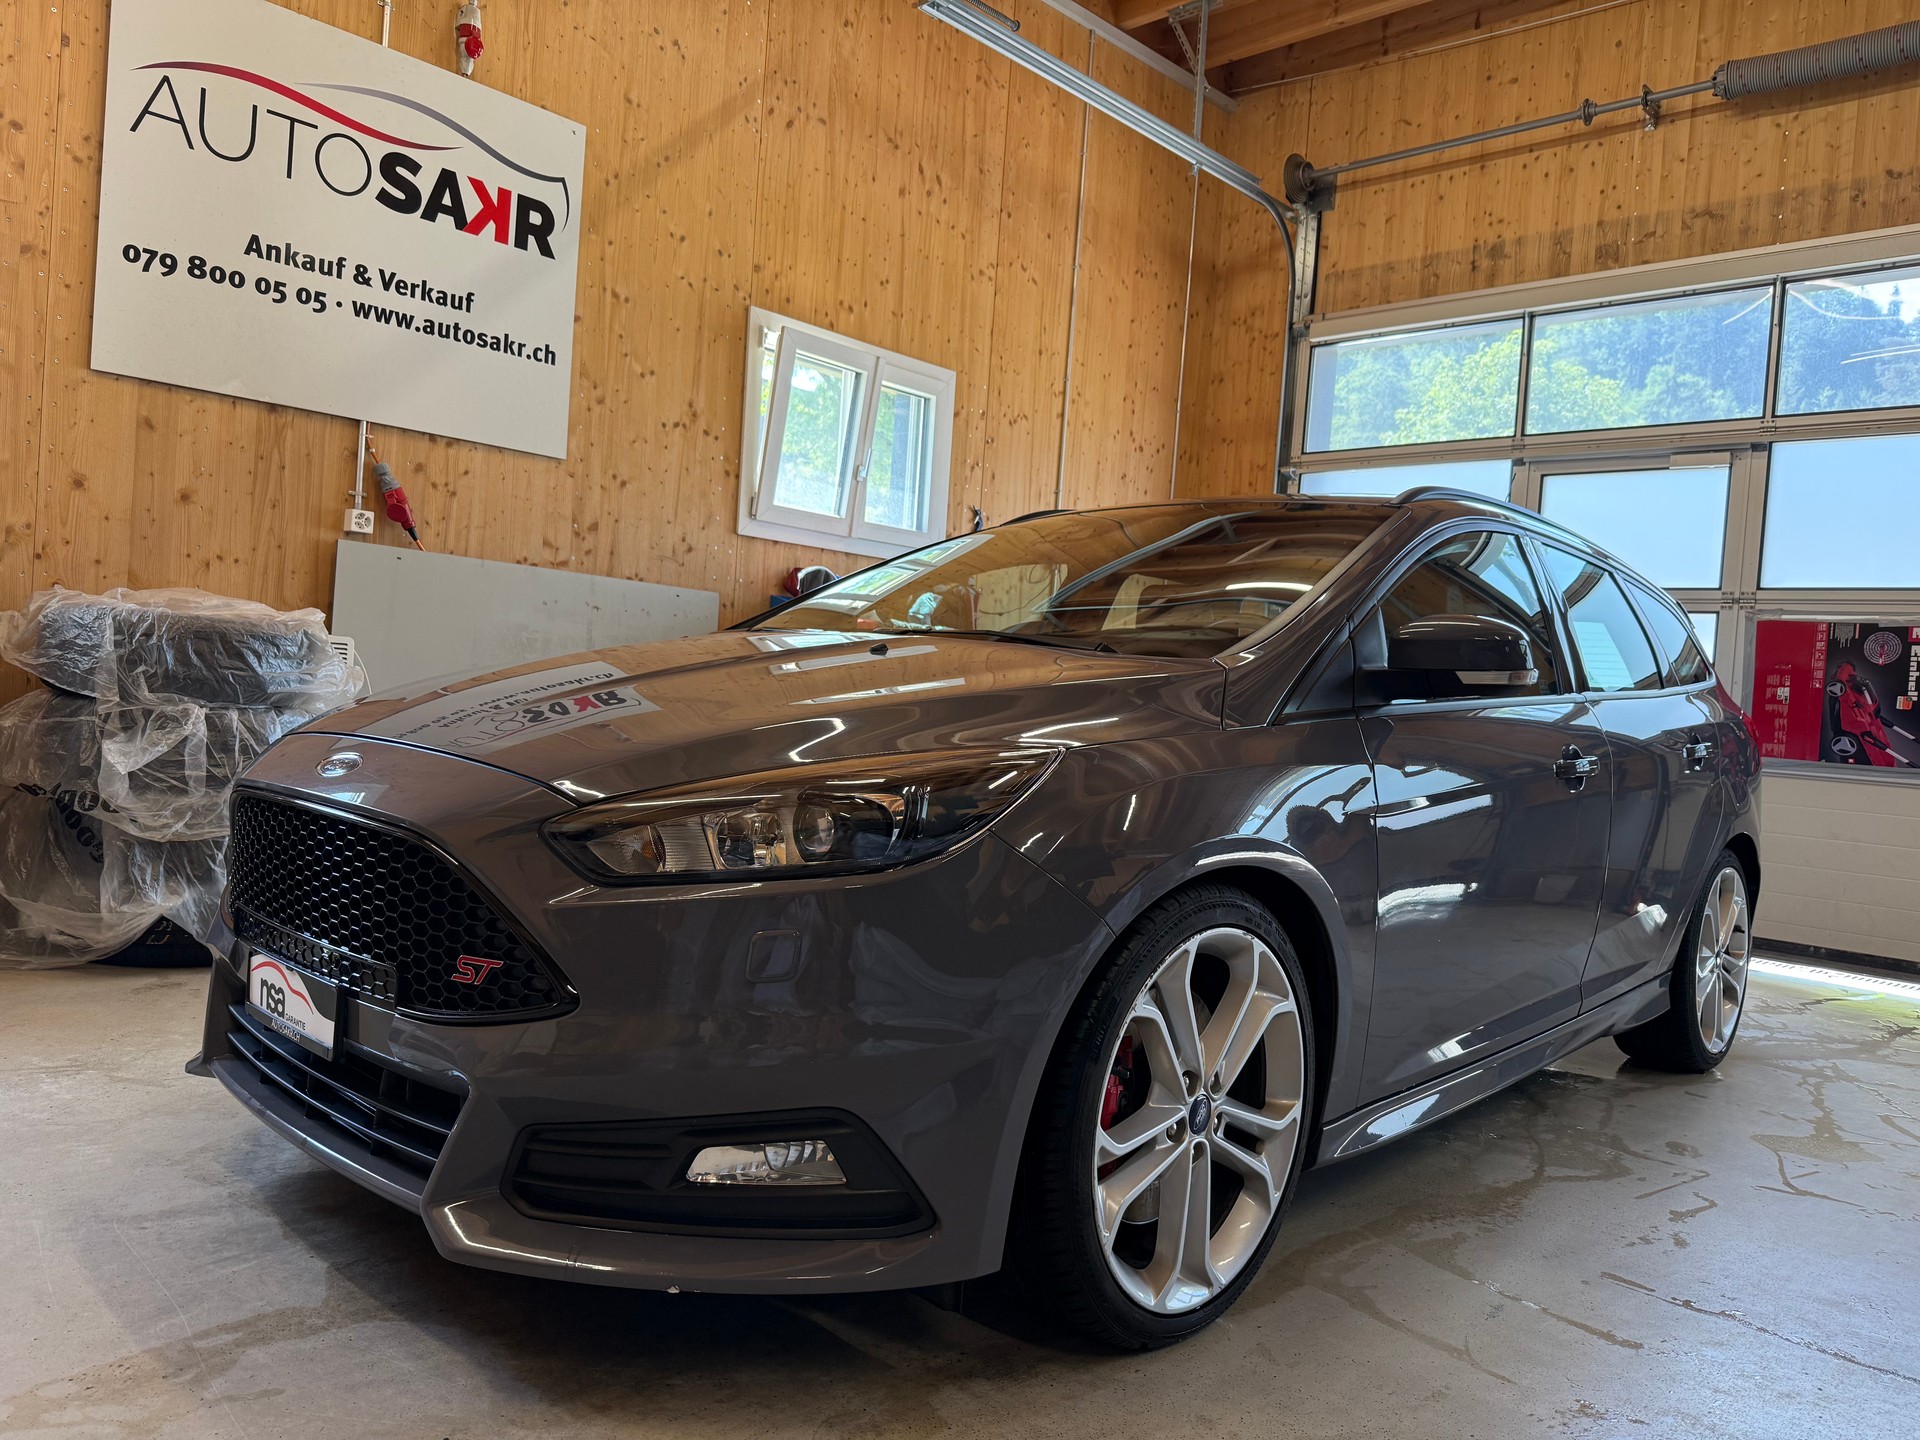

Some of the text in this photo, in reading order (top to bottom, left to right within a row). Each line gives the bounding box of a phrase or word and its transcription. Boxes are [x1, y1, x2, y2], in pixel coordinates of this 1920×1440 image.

[129, 74, 556, 260] AUTOSAKR
[122, 244, 178, 277] 079
[187, 255, 246, 289] 800
[254, 277, 287, 304] 05
[296, 287, 327, 313] 05
[352, 300, 556, 366] www.autosakr.ch
[243, 233, 475, 313] Ankauf & Verkauf
[260, 977, 286, 1019] nsa
[451, 954, 504, 985] ST
